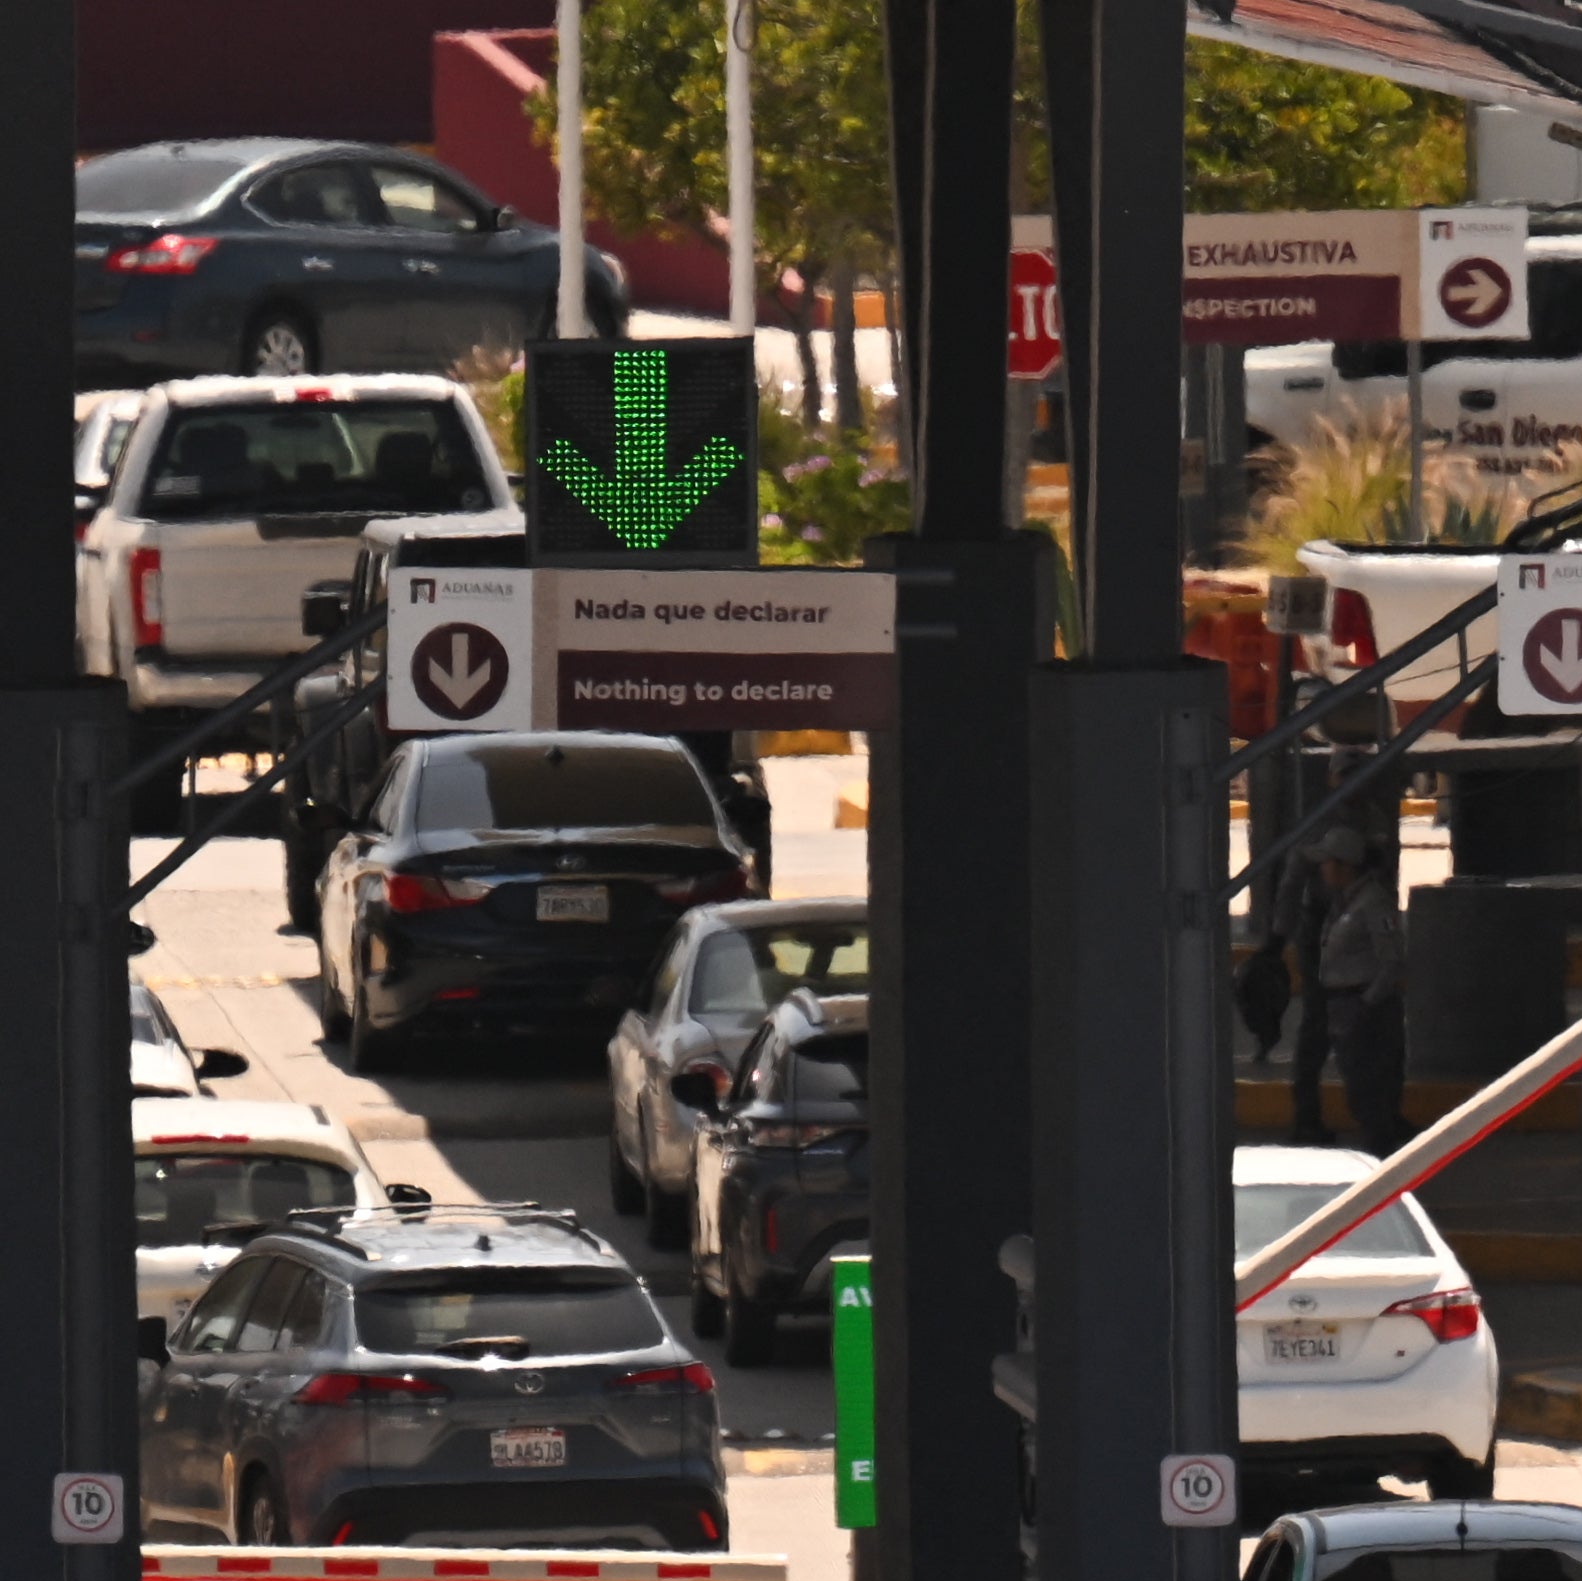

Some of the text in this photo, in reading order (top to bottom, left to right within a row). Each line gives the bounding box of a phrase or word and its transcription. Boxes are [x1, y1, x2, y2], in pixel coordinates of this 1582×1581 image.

[1187, 240, 1358, 267] EXHAUSTIVA
[575, 599, 830, 627] Nada que declarar
[574, 679, 834, 708] Nothing to declare
[1181, 1476, 1213, 1498] 10
[72, 1491, 104, 1516] 10
